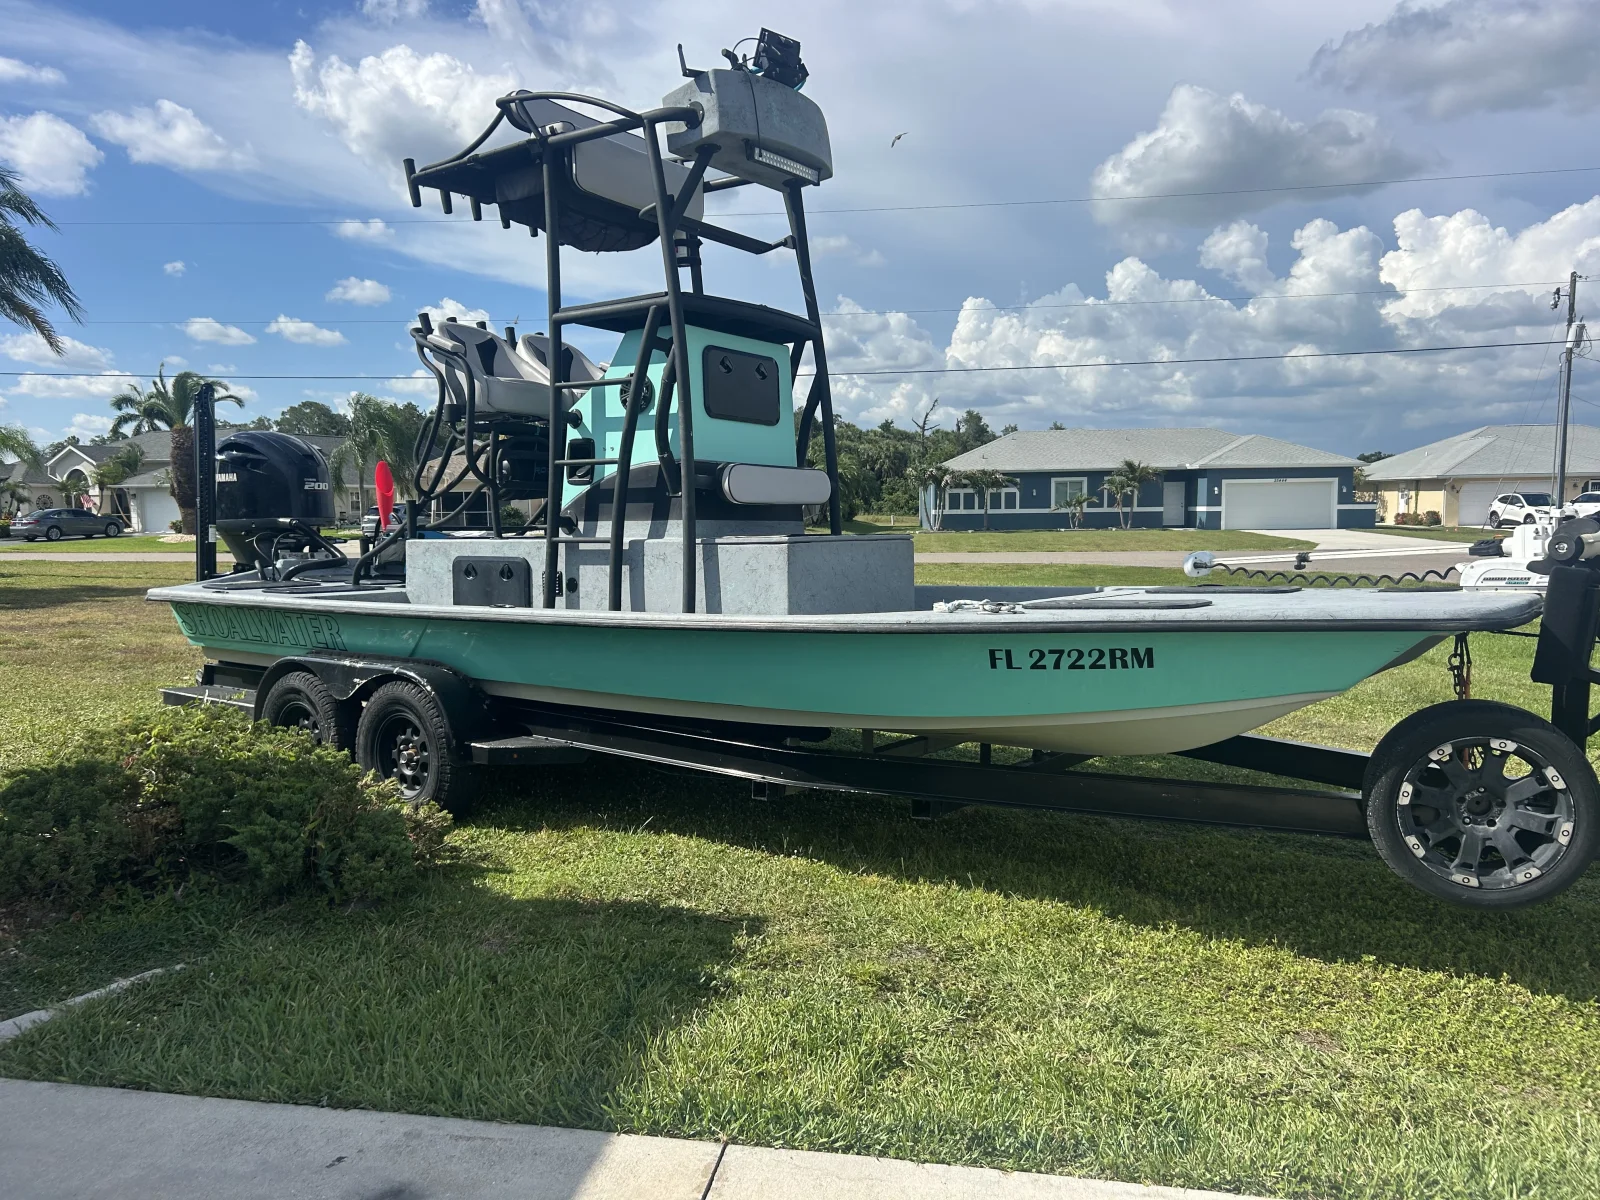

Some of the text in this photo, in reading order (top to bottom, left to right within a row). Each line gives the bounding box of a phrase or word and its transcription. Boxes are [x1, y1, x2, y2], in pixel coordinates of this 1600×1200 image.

[304, 482, 328, 490] 200
[176, 602, 348, 651] SHOALWATER
[988, 647, 1154, 670] FL 2722RM
